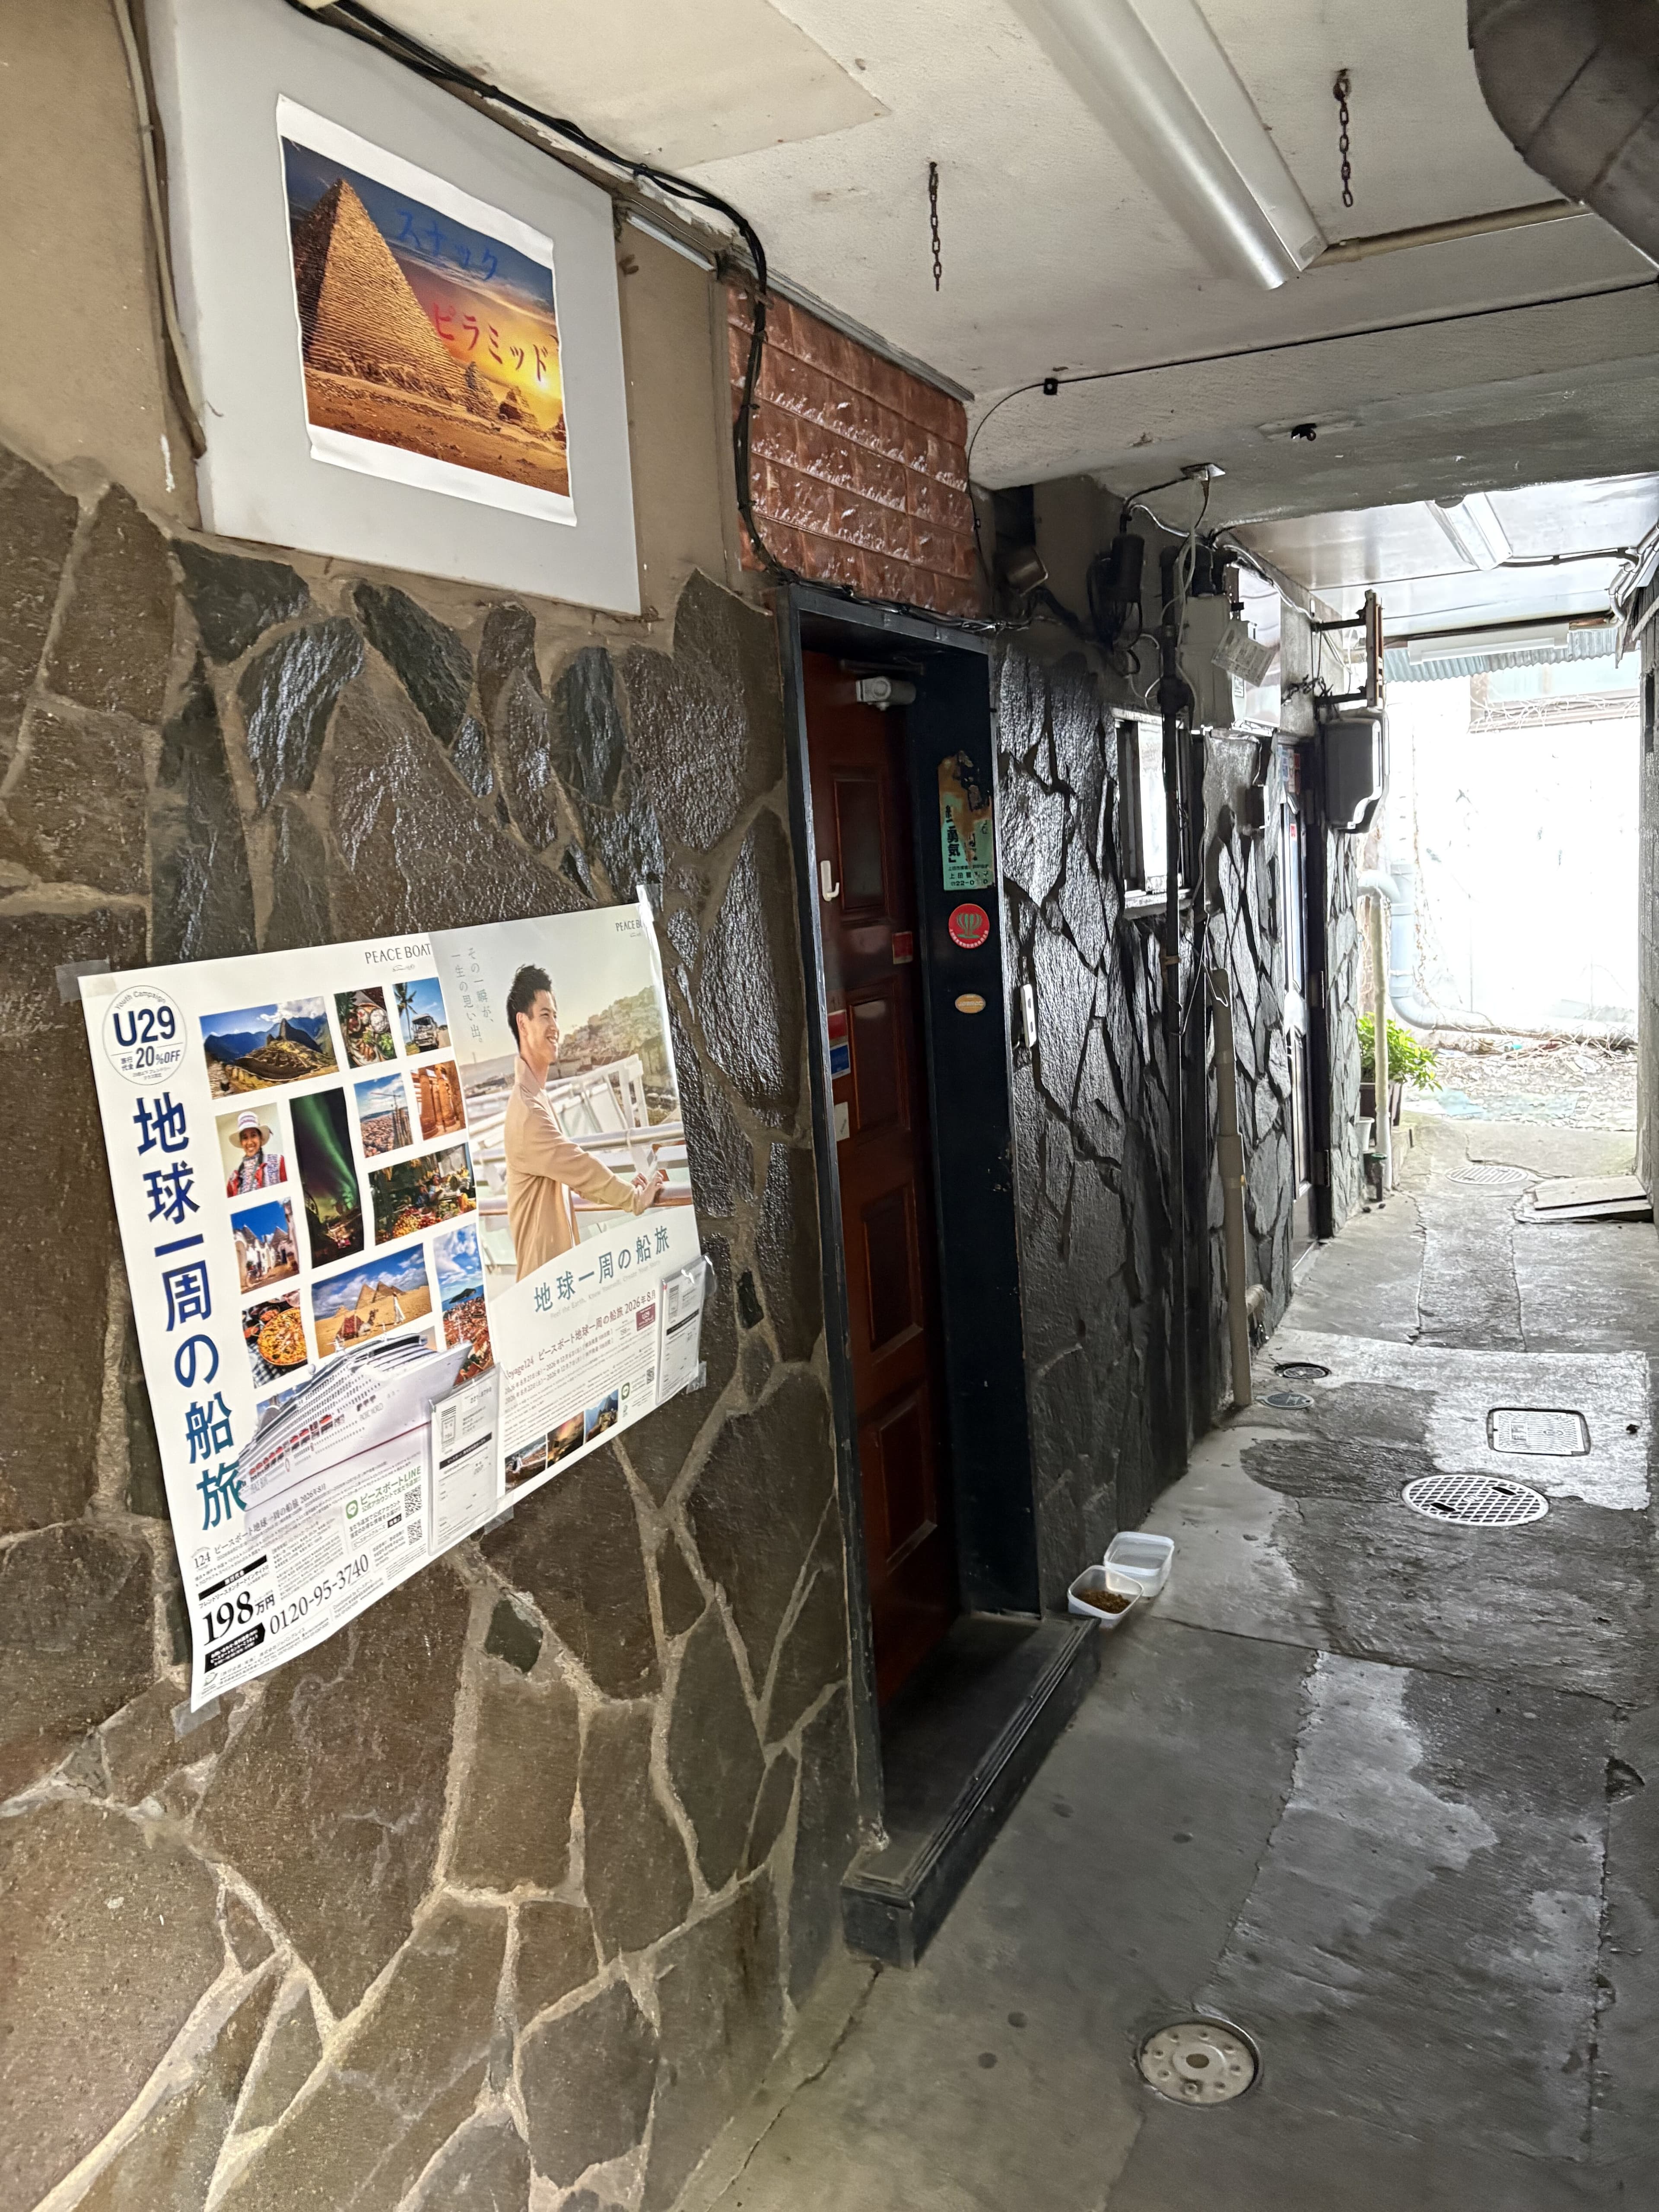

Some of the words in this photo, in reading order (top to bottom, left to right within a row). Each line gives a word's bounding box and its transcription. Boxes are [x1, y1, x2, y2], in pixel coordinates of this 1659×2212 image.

[397, 211, 498, 280] スナック
[435, 303, 548, 381] ピラミッド
[615, 920, 636, 932] PEACE
[365, 948, 402, 964] PEACE
[404, 943, 432, 958] BOAT
[114, 994, 133, 1010] Youth
[133, 991, 166, 1003] Campaign
[451, 954, 482, 1042] 一生の思い出。
[469, 947, 493, 1022] その一瞬が、
[112, 1005, 175, 1046] U29
[136, 1046, 181, 1068] 20%OFF
[534, 1226, 669, 1313] 地球一周の船旅
[132, 1092, 247, 1531] 地球一周の船旅
[625, 1290, 655, 1314] 2026年8月
[360, 1465, 421, 1505] ピースボートLINE
[194, 1551, 211, 1569] 124
[270, 1554, 369, 1634] 0120-95-3740
